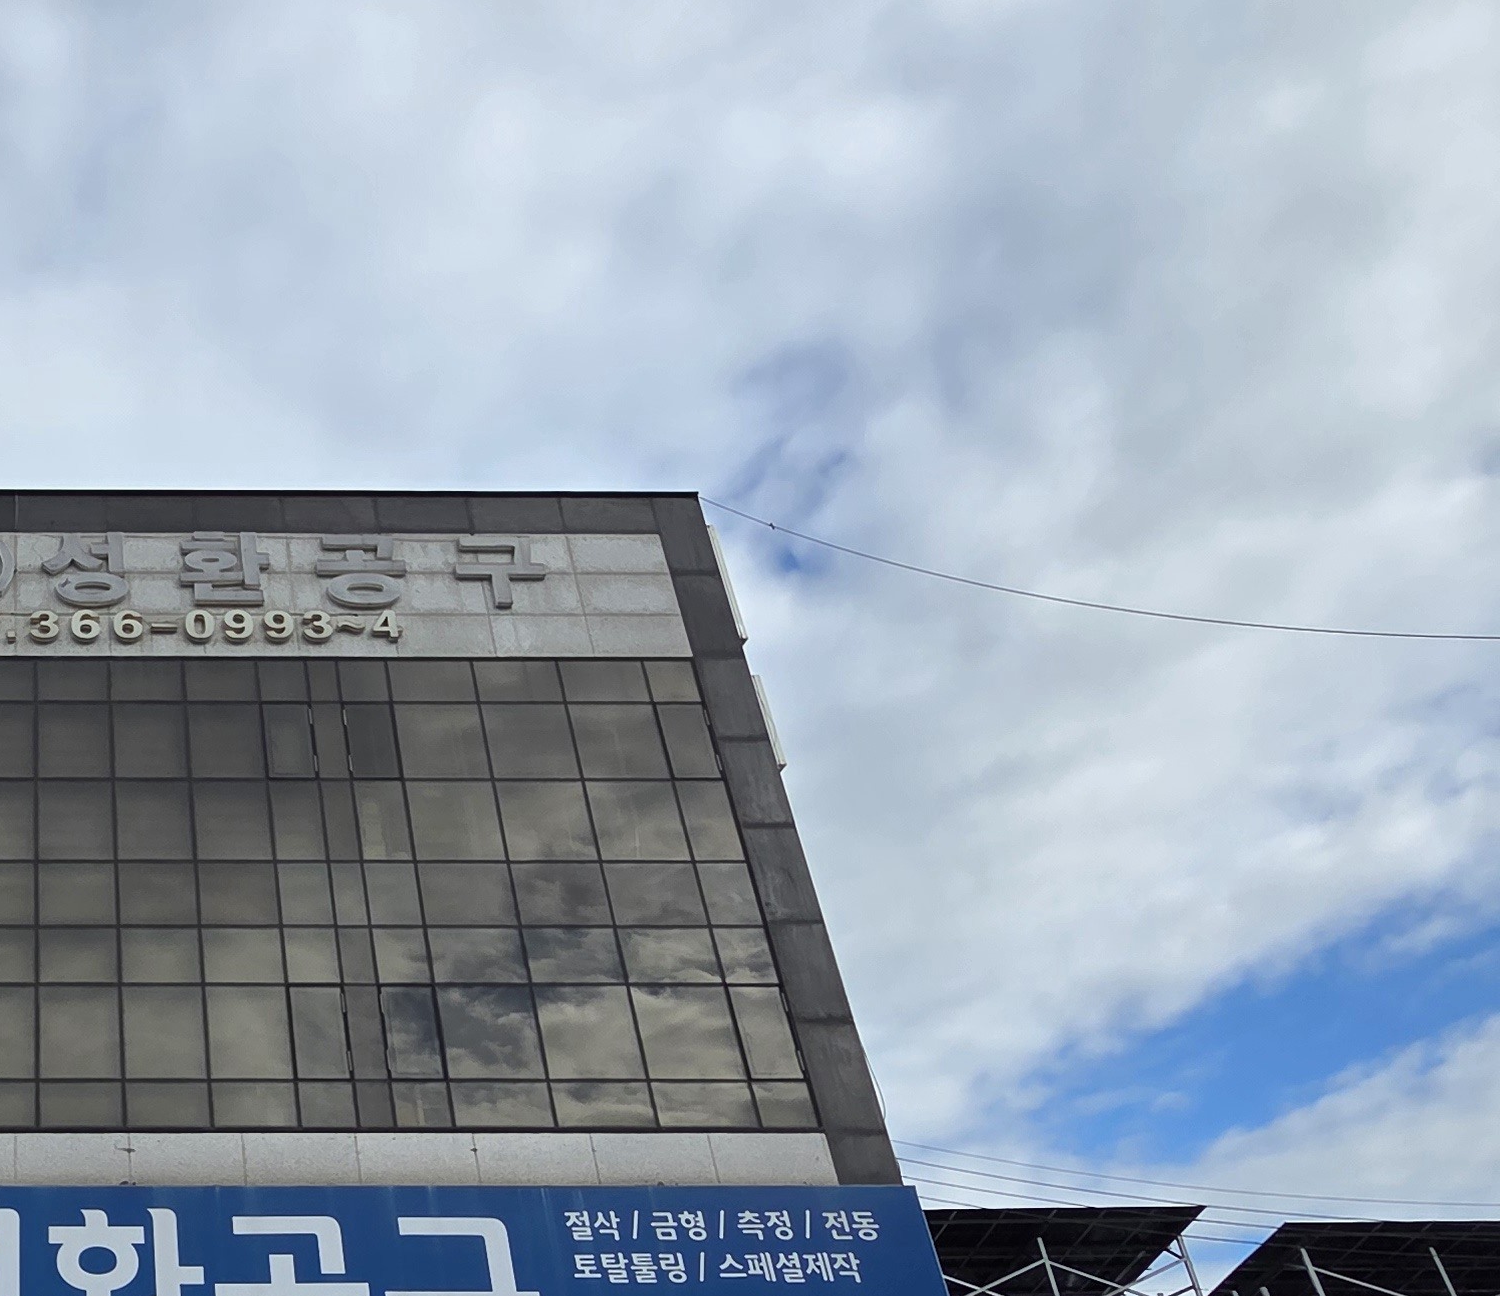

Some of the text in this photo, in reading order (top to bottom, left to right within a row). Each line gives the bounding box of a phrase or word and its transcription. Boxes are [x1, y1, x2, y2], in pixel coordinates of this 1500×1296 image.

[563, 1209, 620, 1241] 절삭
[650, 1210, 708, 1241] 금형
[736, 1210, 794, 1241] 측정
[821, 1210, 880, 1241] 전동
[573, 1251, 688, 1284] 토탈툴링
[718, 1251, 862, 1284] 스페셜제작
